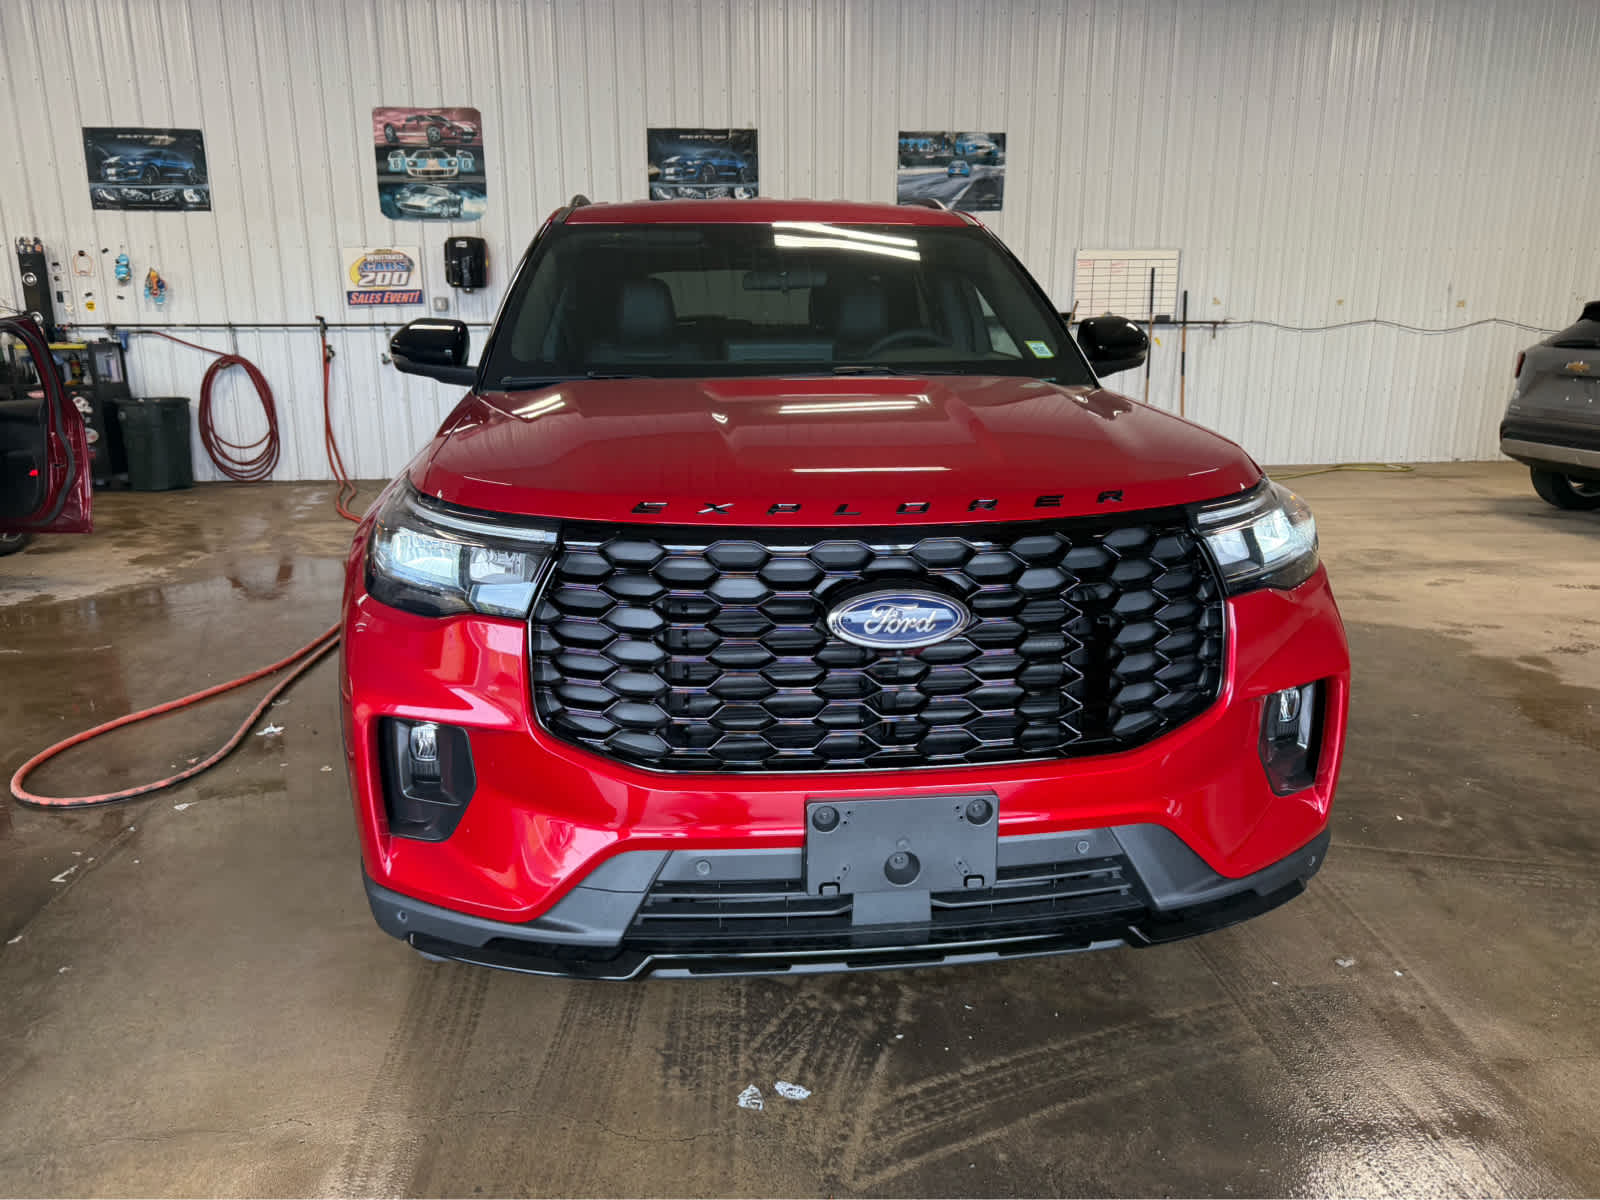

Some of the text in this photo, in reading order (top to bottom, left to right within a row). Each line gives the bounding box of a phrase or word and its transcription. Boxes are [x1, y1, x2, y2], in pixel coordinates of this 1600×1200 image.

[359, 271, 409, 287] 200
[350, 291, 420, 304] SALES EVENT!
[631, 490, 1124, 516] EXPLORER
[863, 602, 937, 635] Ford
